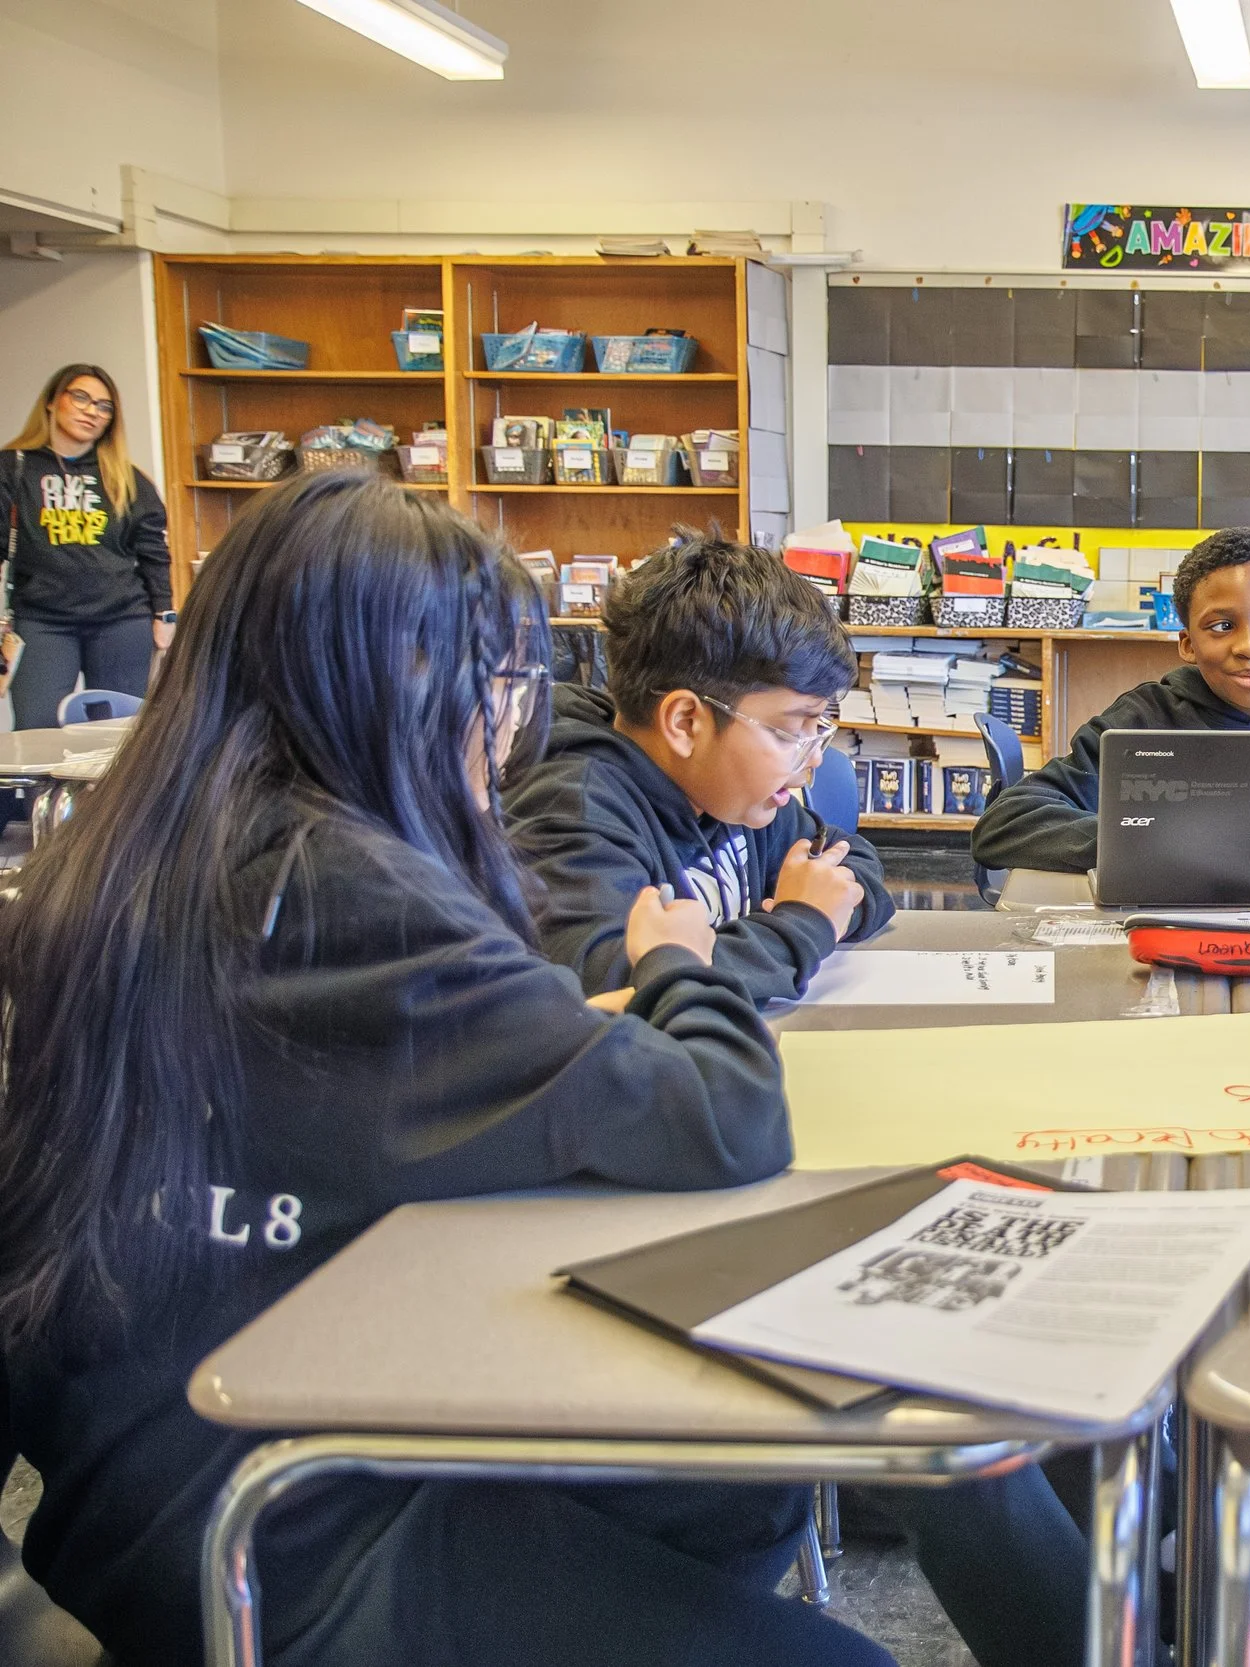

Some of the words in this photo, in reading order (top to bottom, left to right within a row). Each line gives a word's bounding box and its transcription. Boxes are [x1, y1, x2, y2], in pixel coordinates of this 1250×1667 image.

[1120, 780, 1189, 801] NYC
[1120, 817, 1155, 827] acer
[1016, 1130, 1195, 1152] Penalty
